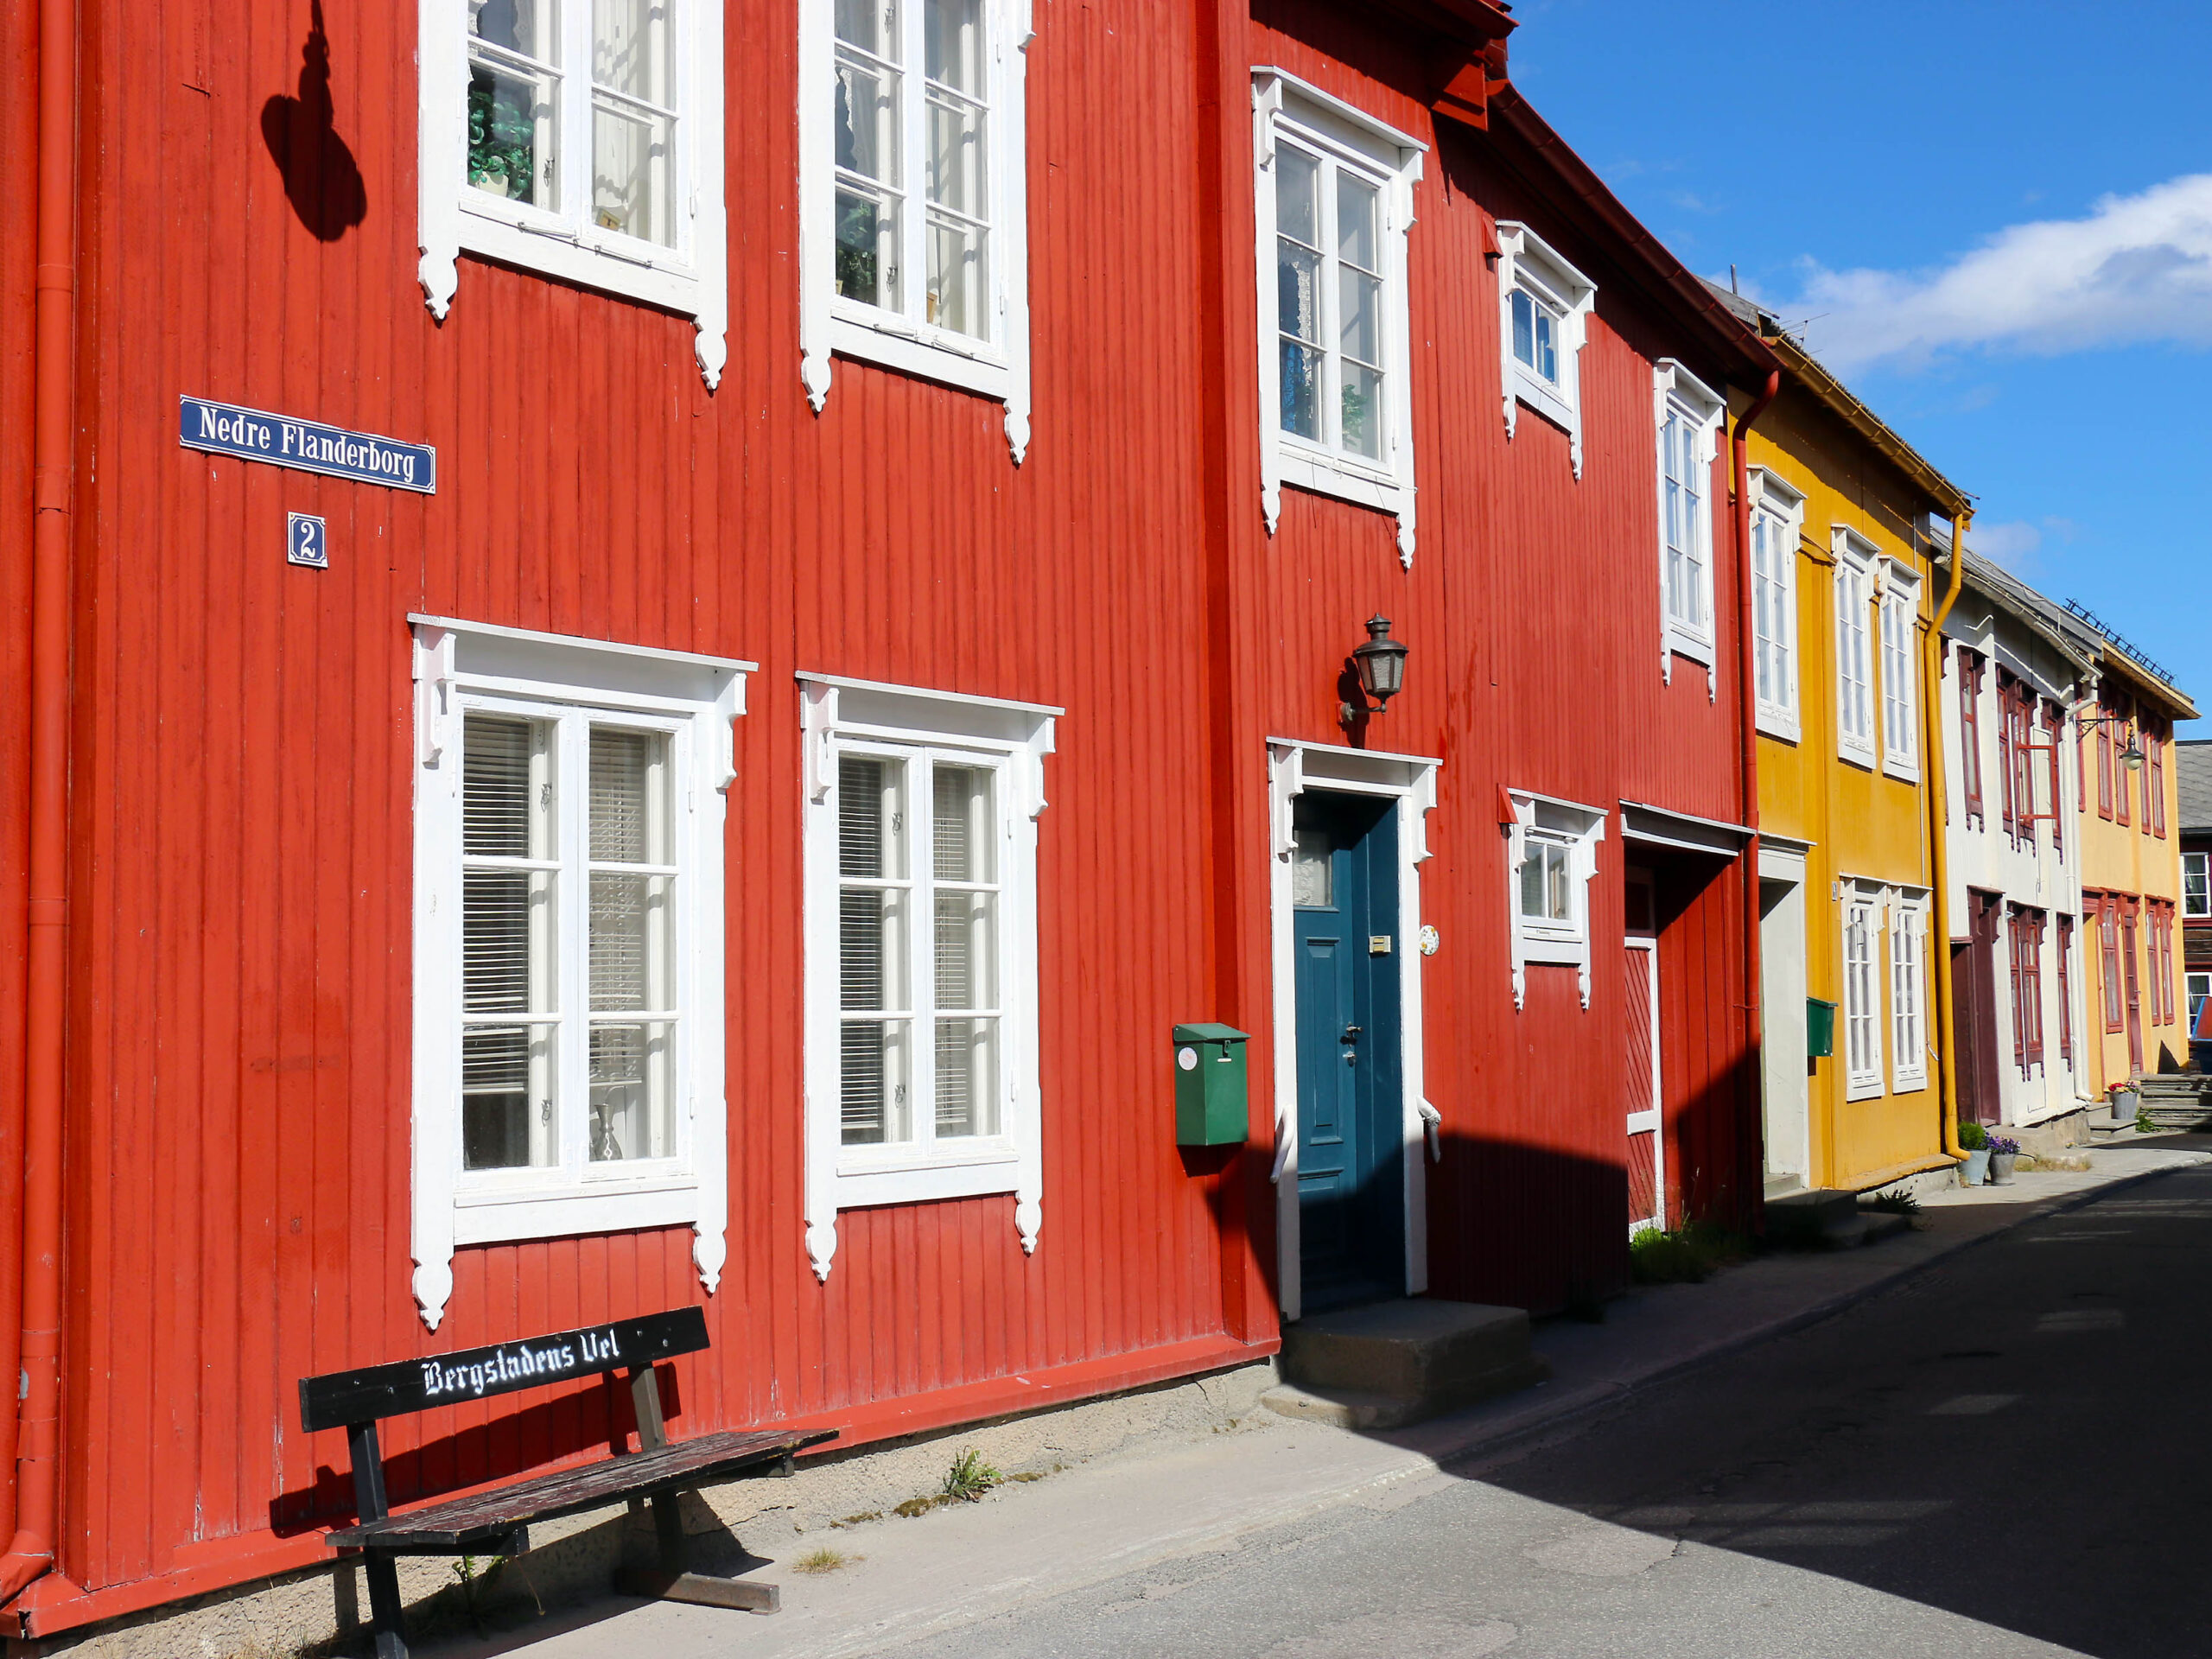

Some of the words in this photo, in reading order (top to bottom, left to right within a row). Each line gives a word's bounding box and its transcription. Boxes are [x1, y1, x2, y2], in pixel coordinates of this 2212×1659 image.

[199, 406, 270, 450] Nedre
[281, 423, 416, 483] Flanderborg
[300, 521, 316, 558] 2
[421, 1344, 575, 1395] Bergstadens
